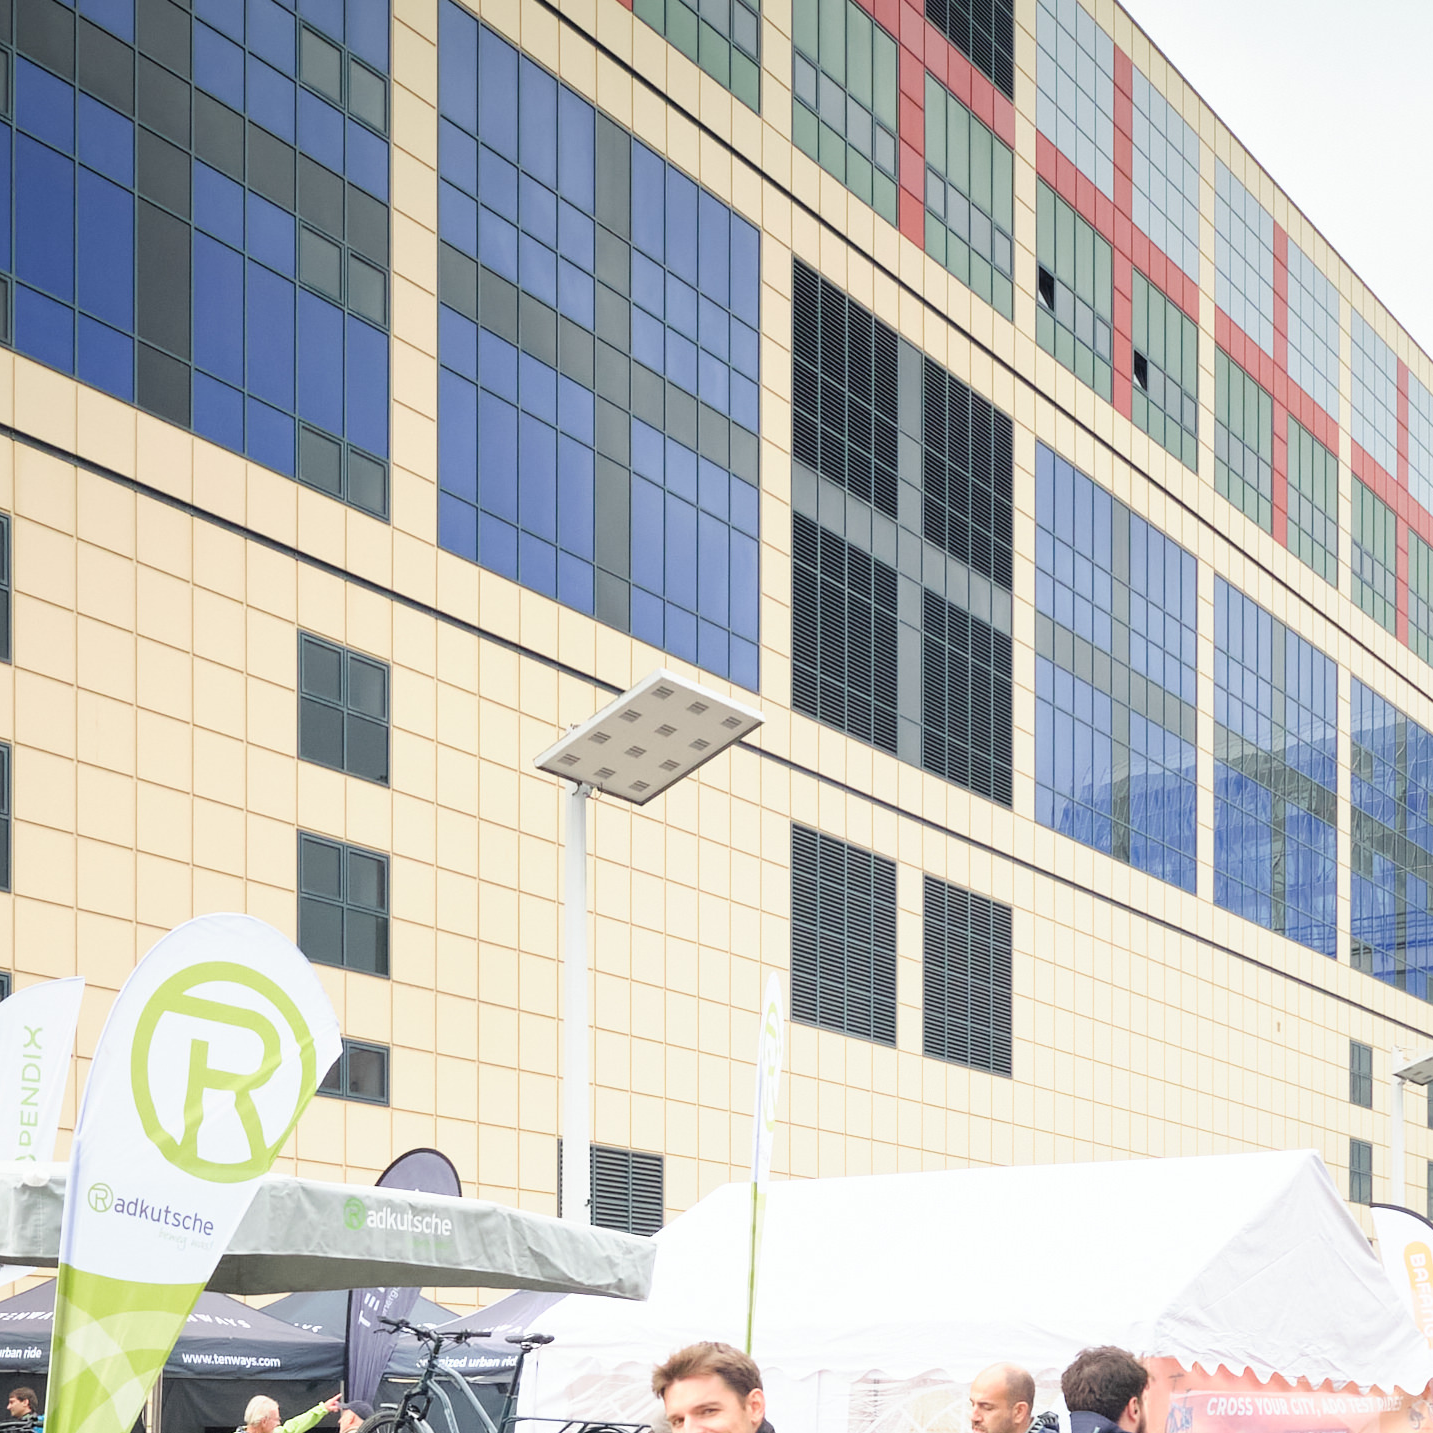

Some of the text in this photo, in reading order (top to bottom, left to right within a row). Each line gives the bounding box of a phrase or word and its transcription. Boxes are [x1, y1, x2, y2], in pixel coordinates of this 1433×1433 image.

[19, 1025, 43, 1160] PENDIX
[184, 1312, 251, 1330] NWAYS
[182, 1351, 281, 1368] www.tenways.com
[501, 1355, 518, 1367] rid
[1206, 1397, 1253, 1416] CROSS
[1256, 1397, 1288, 1416] YOUR
[1292, 1397, 1321, 1418] CITY,
[1348, 1397, 1376, 1414] TEST
